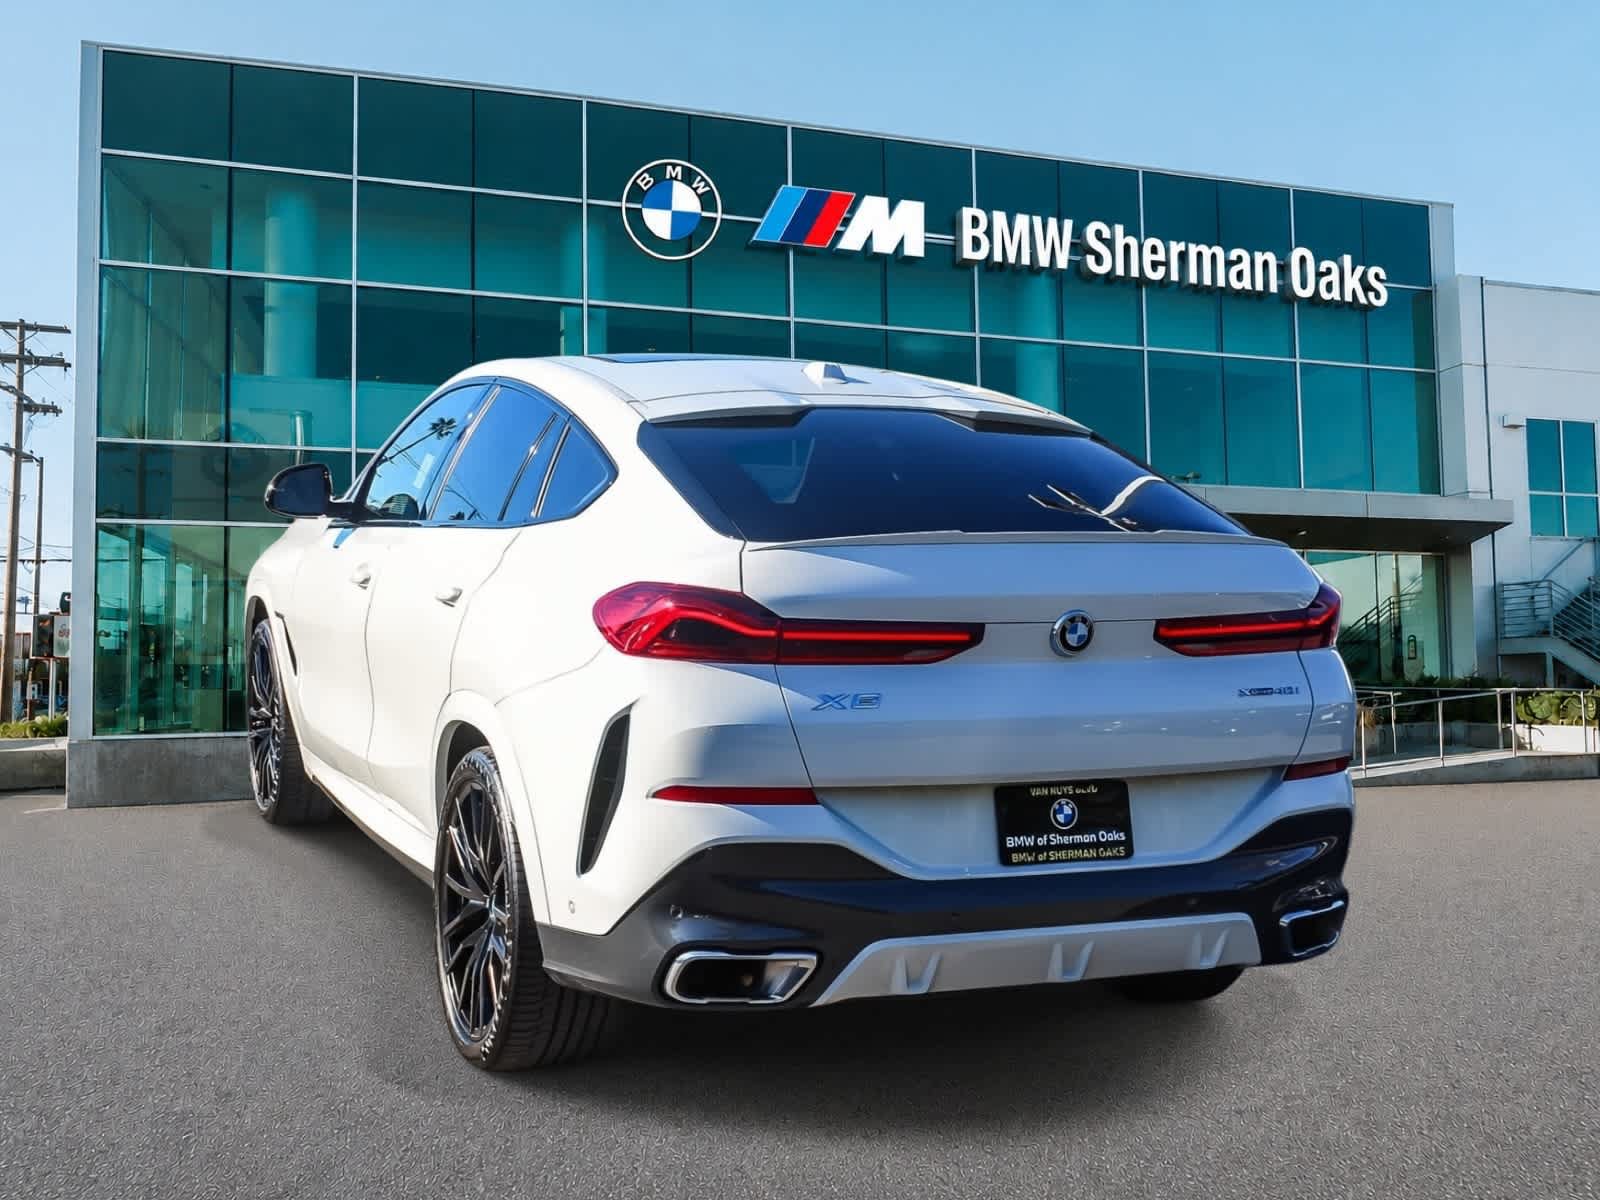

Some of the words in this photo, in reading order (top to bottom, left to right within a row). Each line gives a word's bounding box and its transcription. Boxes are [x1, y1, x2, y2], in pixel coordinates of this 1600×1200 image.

[636, 165, 711, 194] BMW
[960, 206, 1073, 270] BMW
[1084, 221, 1278, 294] Sherman
[1290, 246, 1389, 308] Oaks
[1030, 786, 1049, 796] VAN
[1006, 835, 1035, 848] BMW
[1037, 834, 1048, 846] of
[1049, 831, 1096, 845] Sherman
[1098, 830, 1126, 842] Oaks
[1011, 852, 1035, 863] BMW
[1038, 851, 1047, 861] of
[1049, 849, 1097, 860] SHERMAN
[1099, 847, 1126, 857] OAKS
